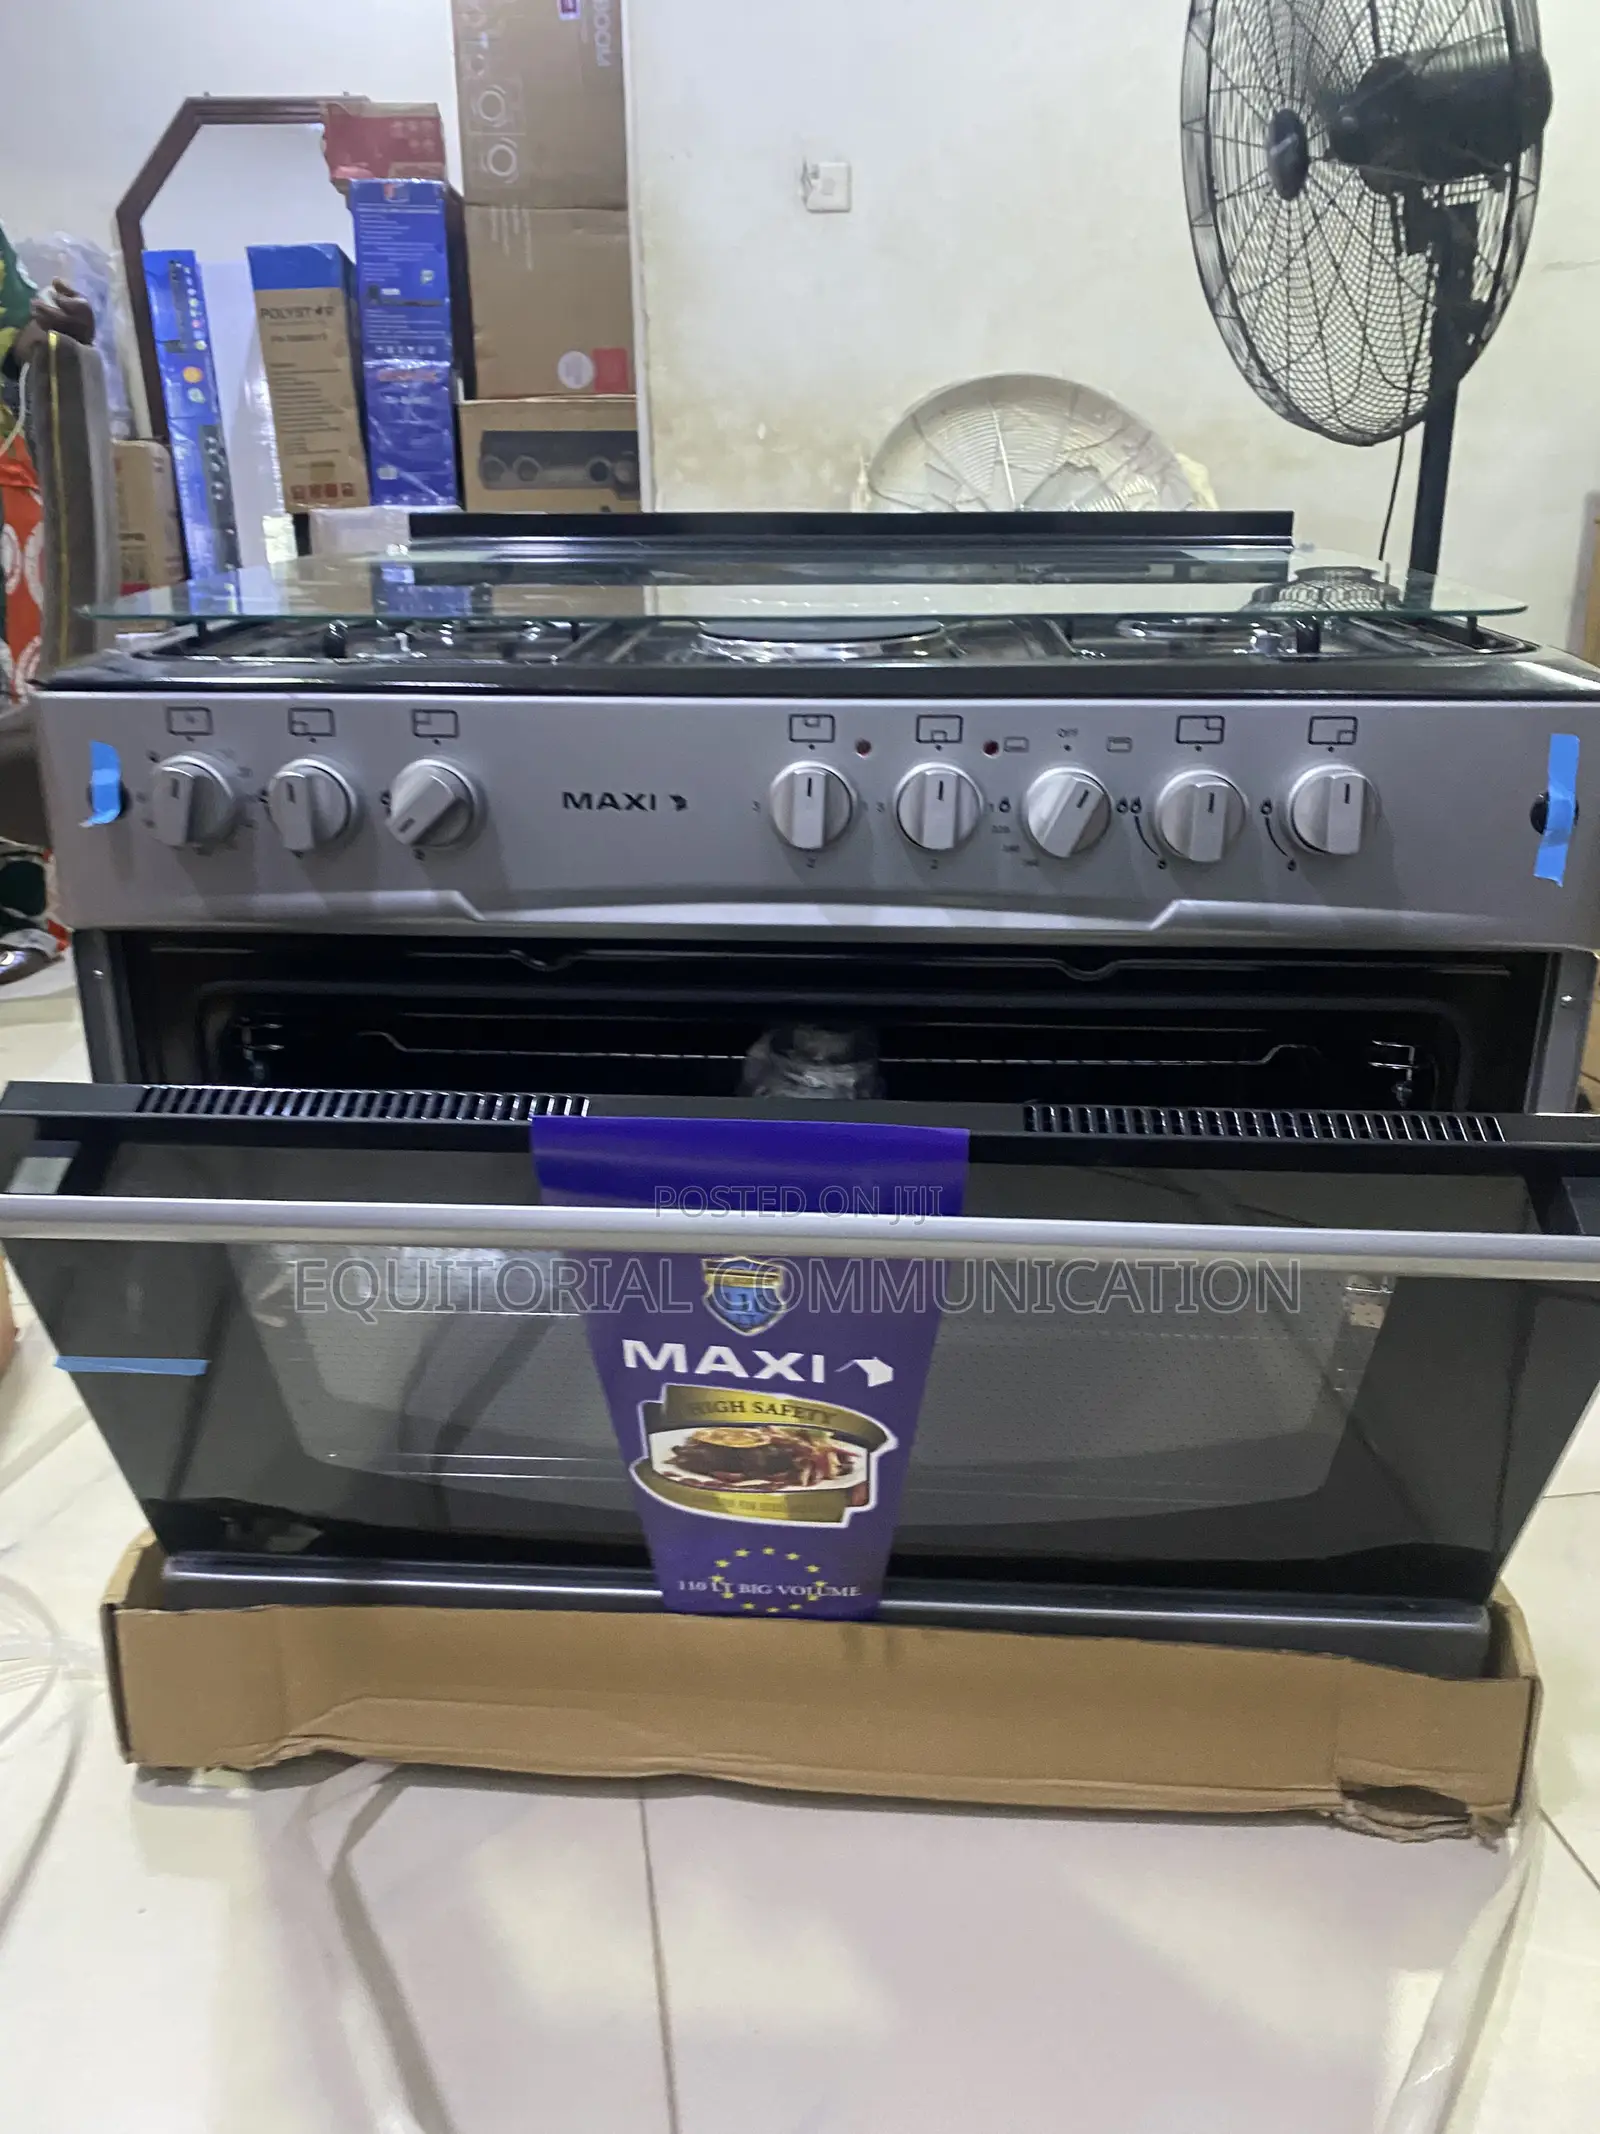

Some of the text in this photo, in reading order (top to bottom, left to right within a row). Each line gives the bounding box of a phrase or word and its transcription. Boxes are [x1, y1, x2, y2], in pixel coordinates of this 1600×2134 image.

[562, 791, 656, 812] MAXI
[622, 1339, 826, 1384] MAXI
[688, 1400, 838, 1425] HIGH SAFETY
[678, 1580, 707, 1592] 110
[738, 1583, 773, 1595] BIG
[776, 1584, 862, 1598] VOLUME
